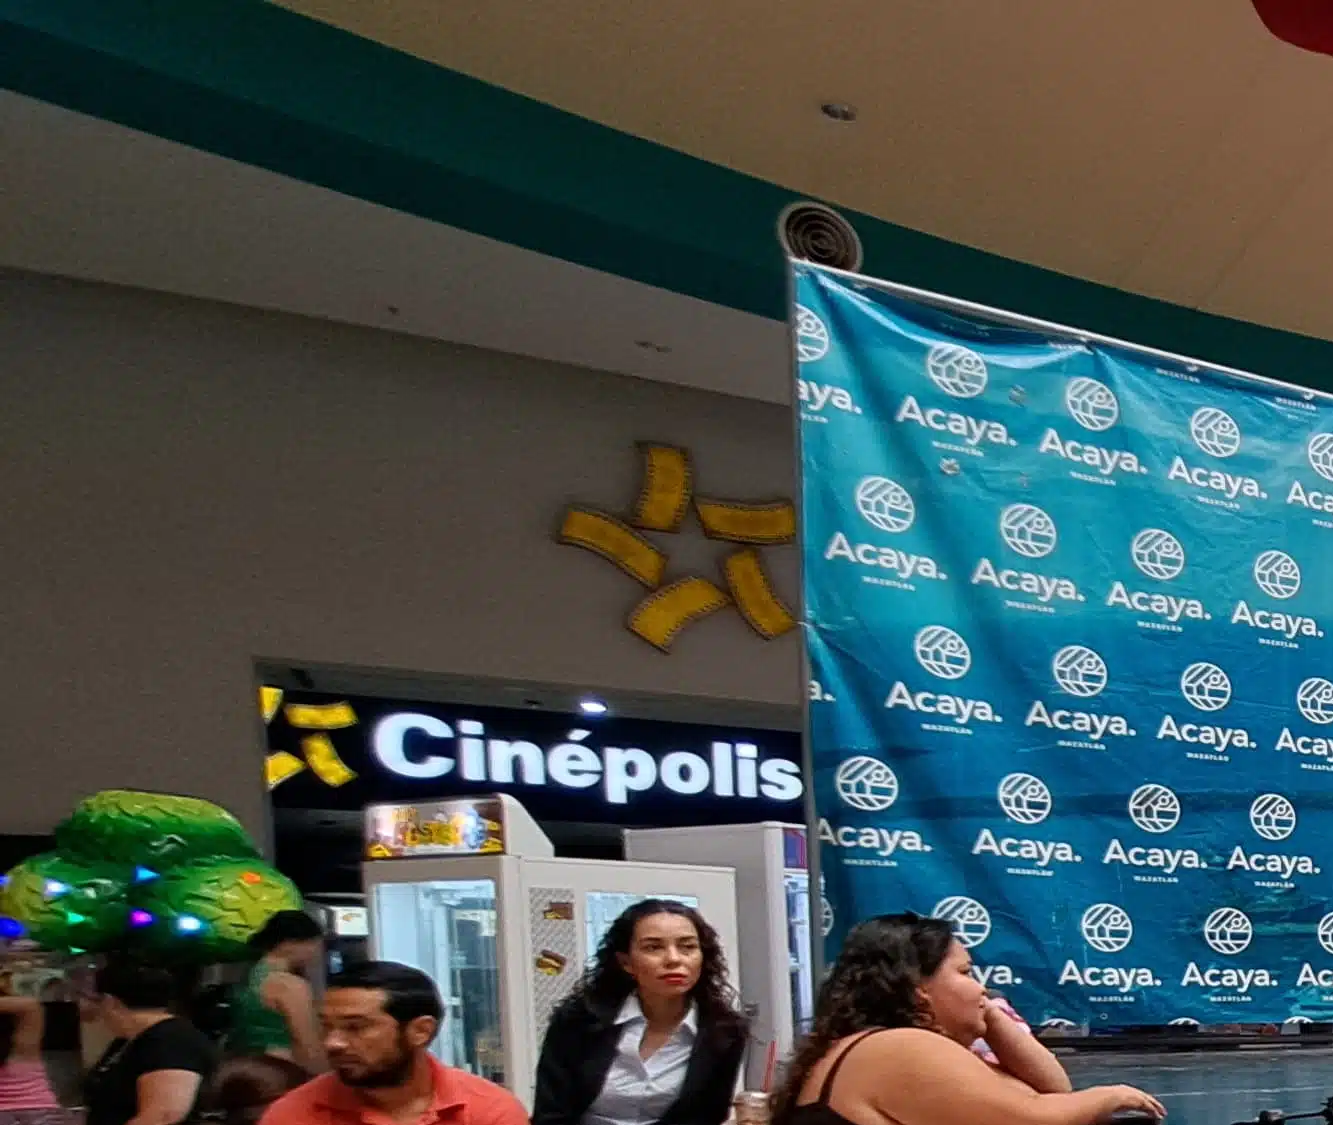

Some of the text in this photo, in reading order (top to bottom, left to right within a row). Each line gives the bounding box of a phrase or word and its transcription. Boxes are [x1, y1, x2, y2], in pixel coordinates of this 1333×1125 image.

[896, 395, 1017, 447] Acaya.
[1040, 428, 1148, 474] Acaya.
[1168, 456, 1268, 499] Acaya.
[826, 532, 948, 580] Acaya.
[972, 558, 1085, 602] Acaya.
[1105, 581, 1211, 622] Acaya.
[1232, 601, 1324, 639] Acaya.
[885, 681, 1002, 725] Acaya.
[1025, 701, 1136, 739] Acaya.
[1157, 715, 1257, 752] Acaya.
[374, 712, 804, 804] Cinépolis
[817, 817, 932, 855] Acaya.
[973, 829, 1082, 866] Acaya.
[1103, 839, 1208, 873] Acaya.
[1227, 845, 1320, 879] Acaya.
[1059, 959, 1161, 993] Acaya.
[1182, 962, 1277, 992] Acaya.
